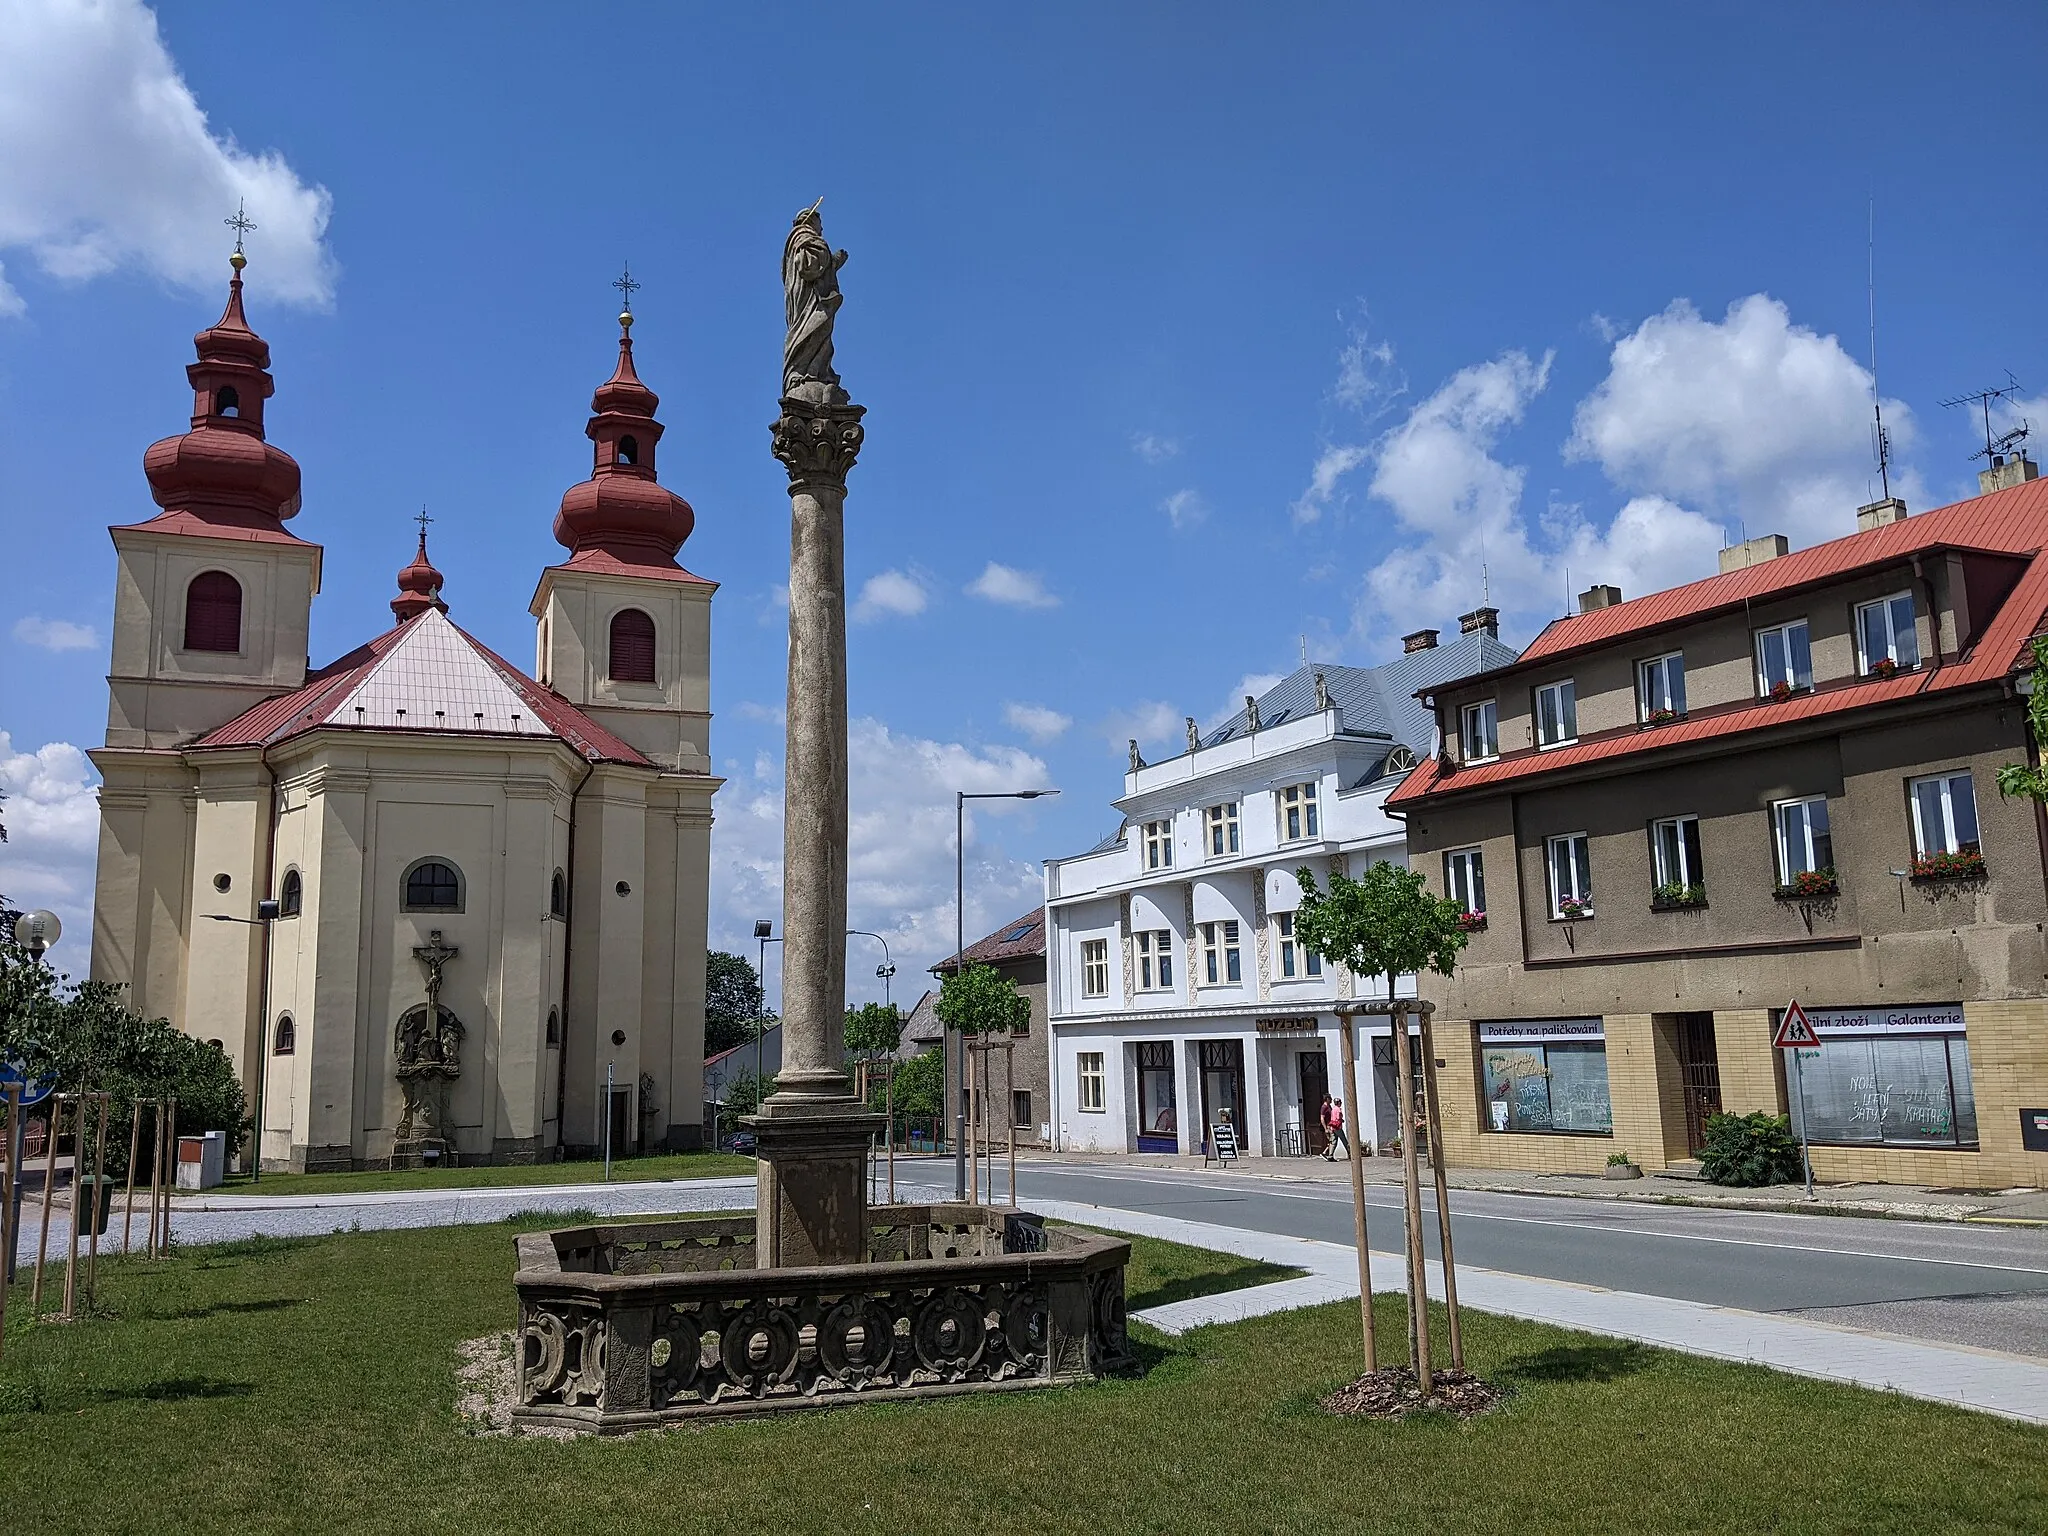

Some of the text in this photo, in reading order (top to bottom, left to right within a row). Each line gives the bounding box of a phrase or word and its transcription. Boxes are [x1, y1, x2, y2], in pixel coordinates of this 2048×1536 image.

[1256, 1017, 1317, 1031] MUZEUM
[1807, 1011, 1961, 1027] tilní zboží Galanterie
[1488, 1023, 1598, 1037] Potřeby na paličkování
